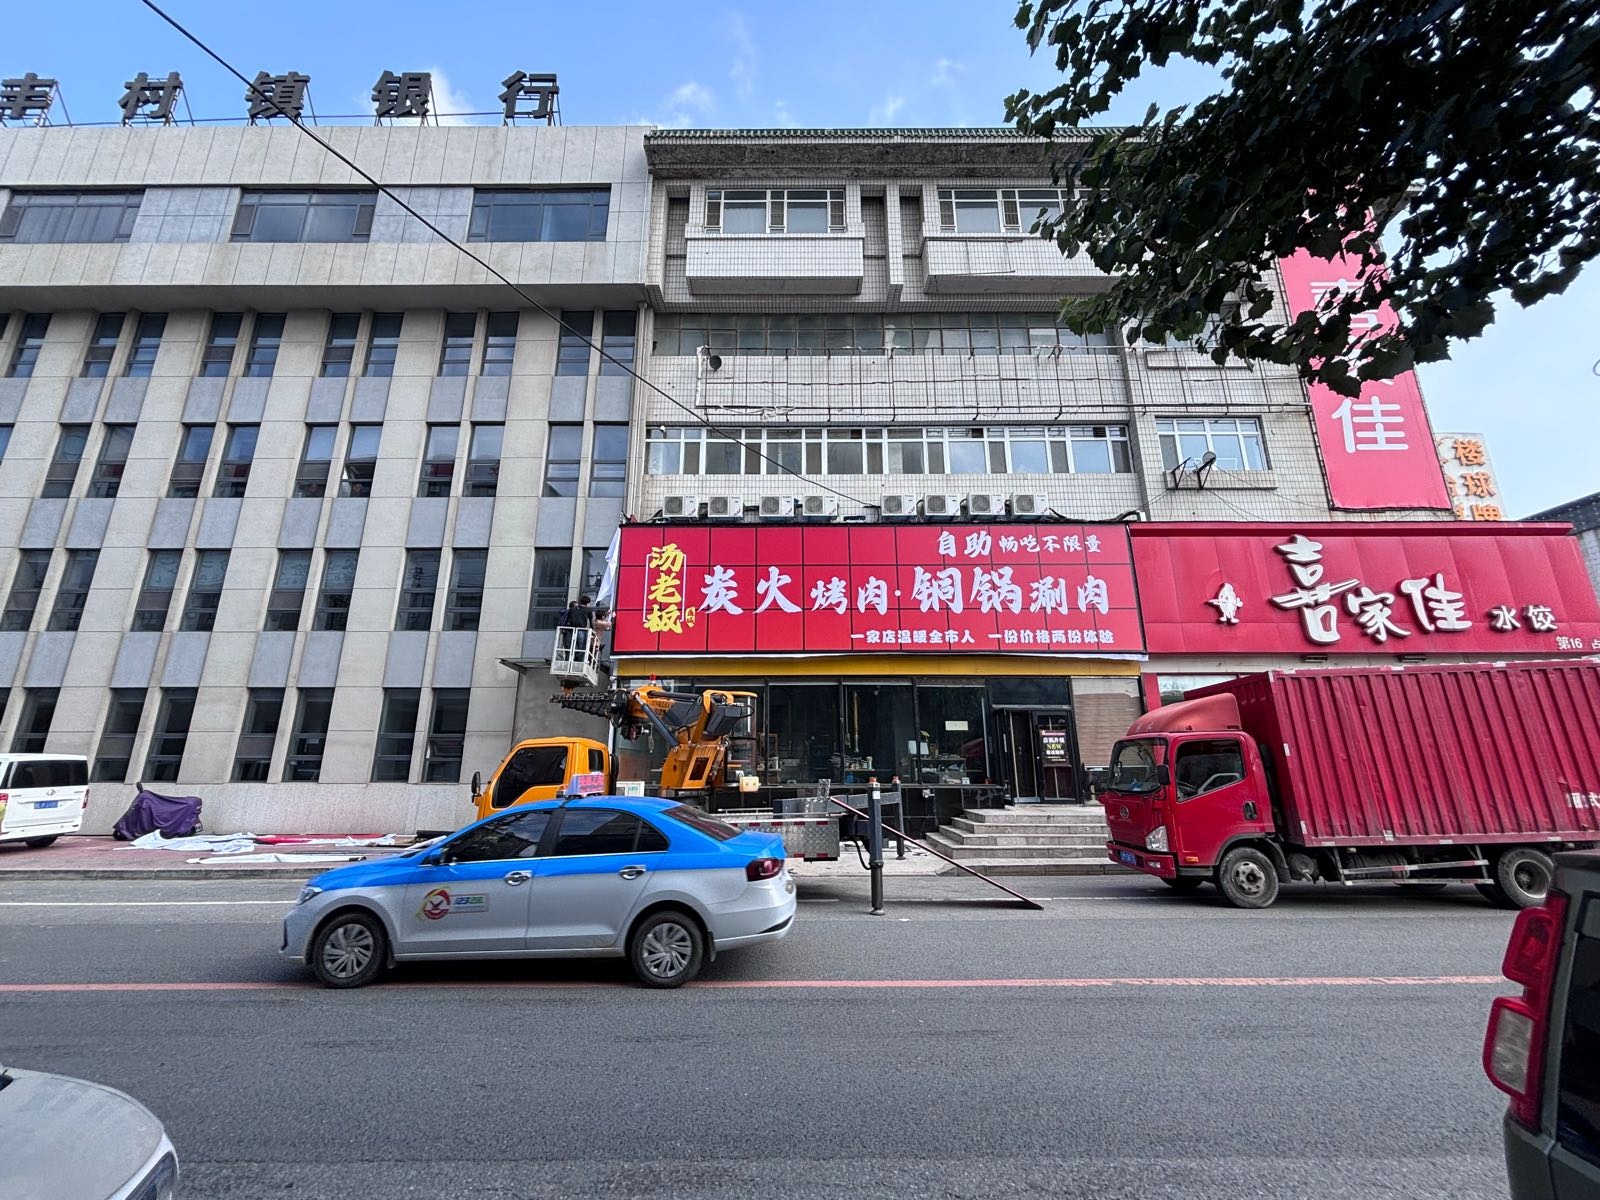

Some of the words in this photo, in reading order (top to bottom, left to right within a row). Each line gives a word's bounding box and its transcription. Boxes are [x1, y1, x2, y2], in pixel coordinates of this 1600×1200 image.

[643, 543, 683, 634] 汤老板
[1271, 534, 1472, 645] 喜家佳
[1489, 604, 1558, 632] 水饺
